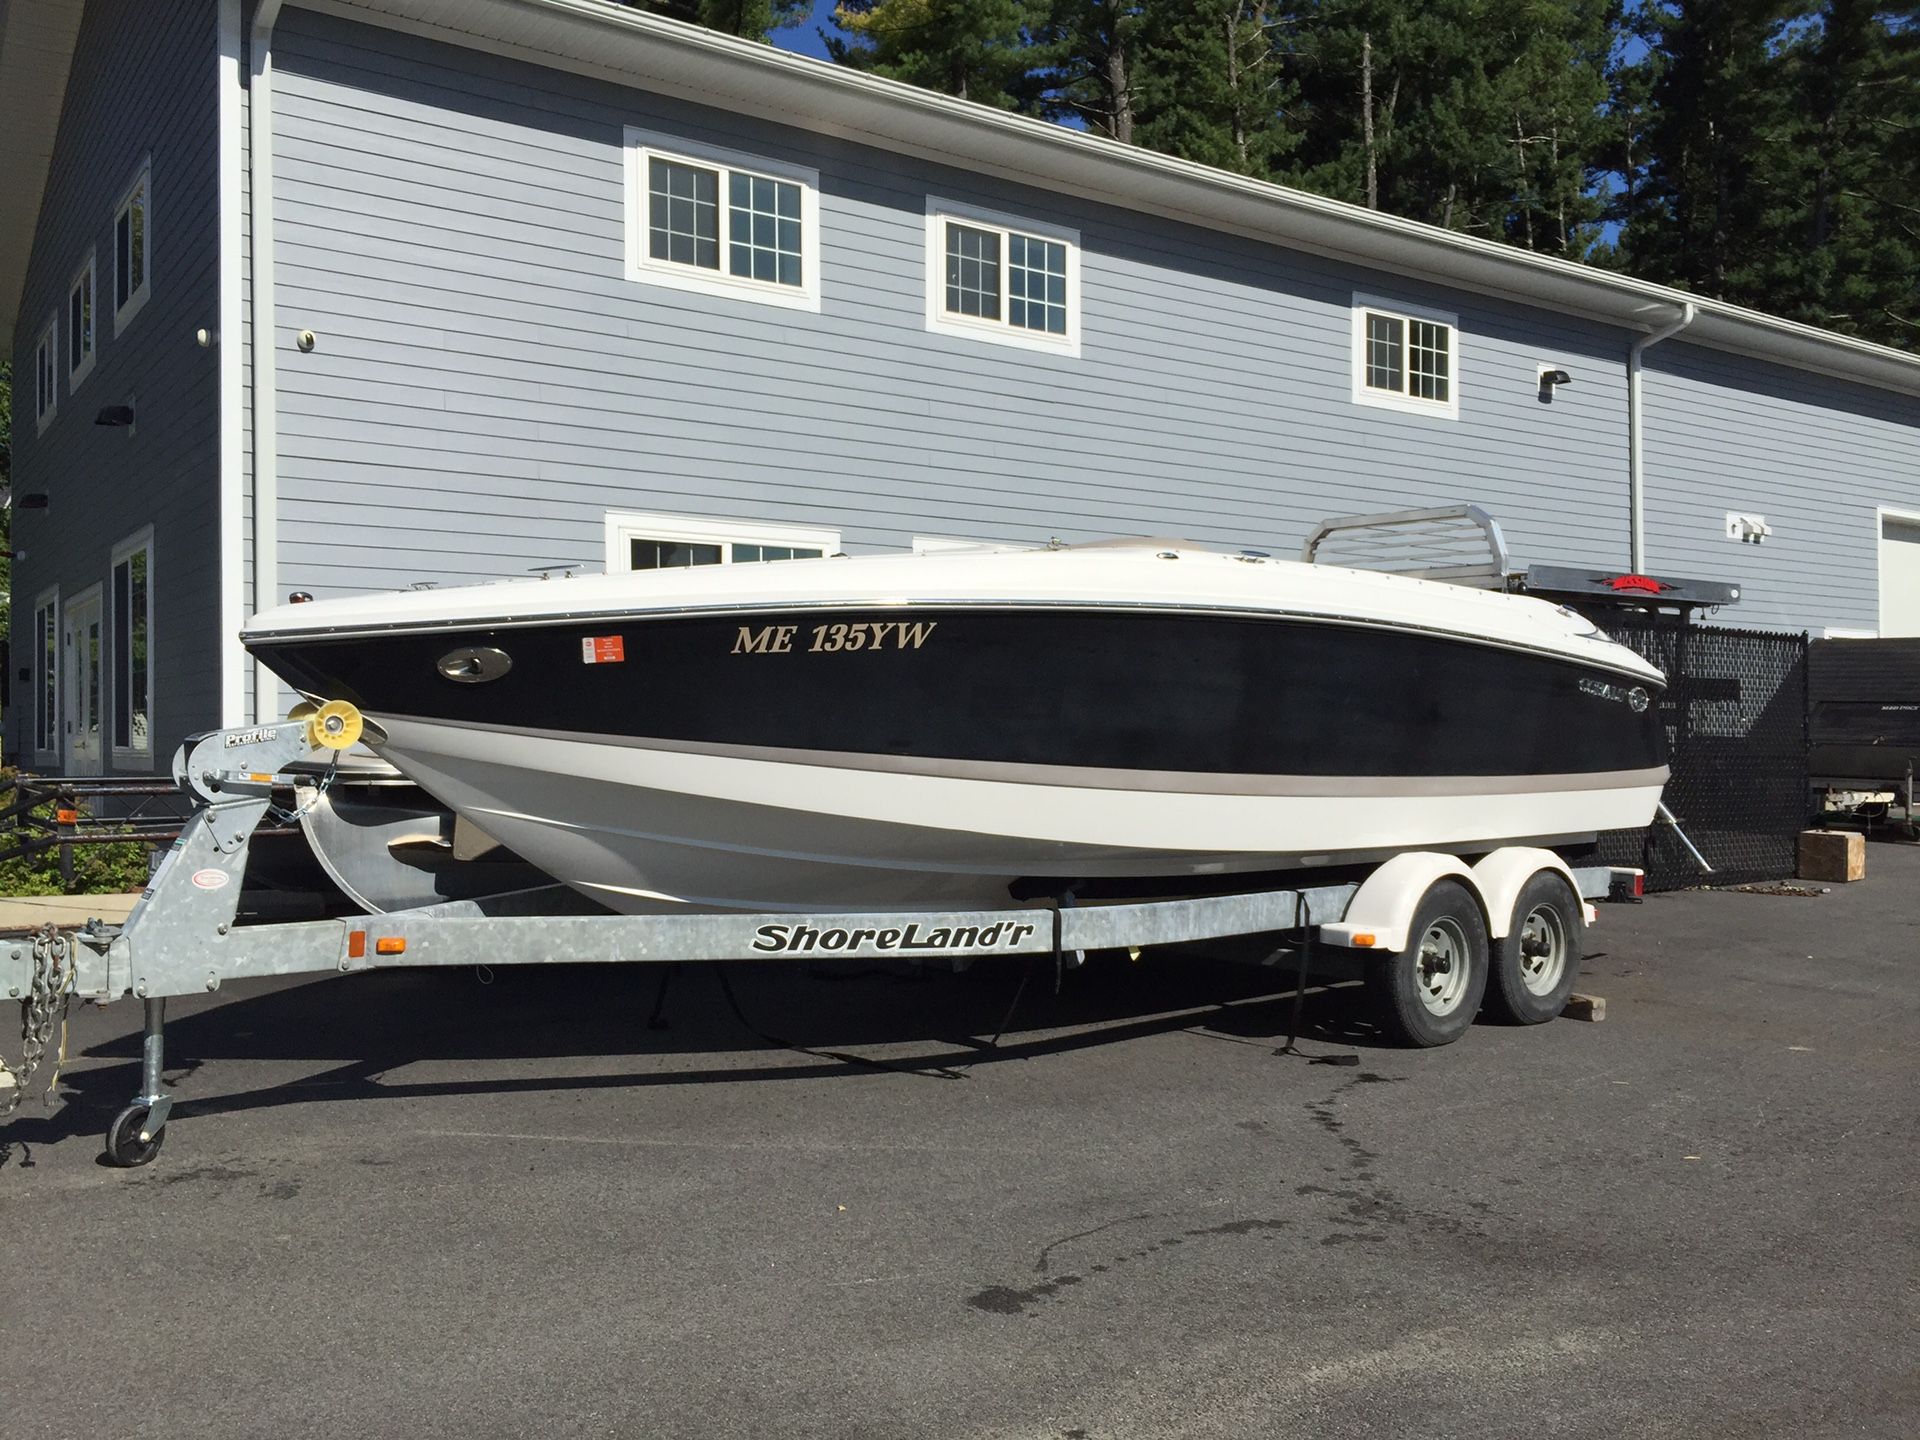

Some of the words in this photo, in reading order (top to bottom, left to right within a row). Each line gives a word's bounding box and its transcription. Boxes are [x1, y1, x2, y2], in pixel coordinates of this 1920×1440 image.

[731, 625, 798, 654] ME
[808, 622, 938, 652] 135YW
[225, 728, 278, 746] Profile
